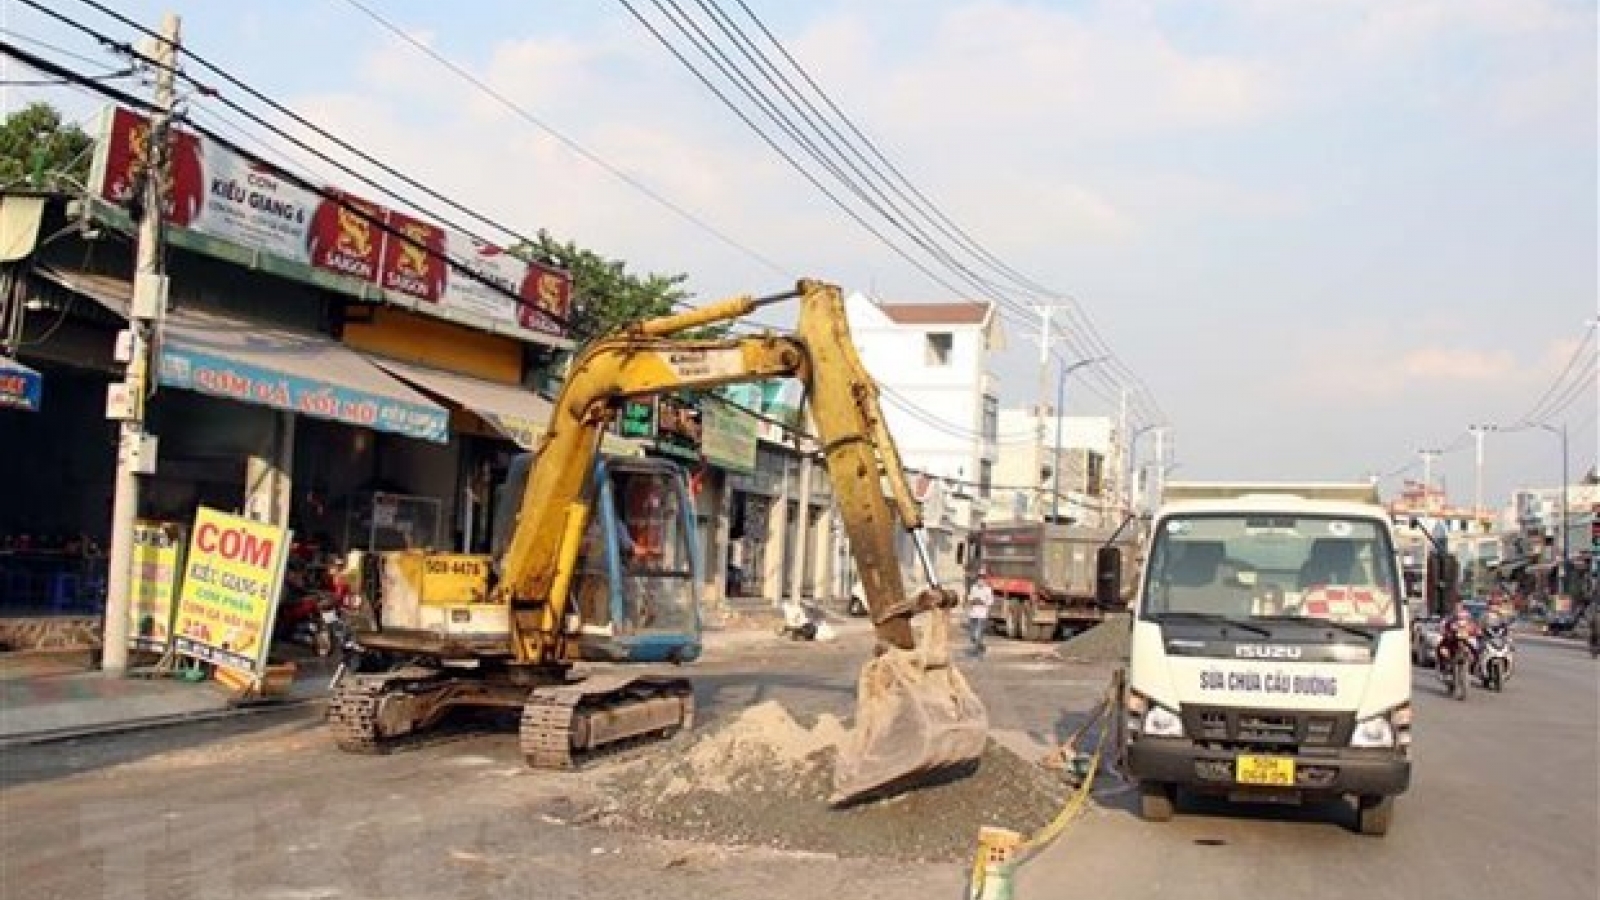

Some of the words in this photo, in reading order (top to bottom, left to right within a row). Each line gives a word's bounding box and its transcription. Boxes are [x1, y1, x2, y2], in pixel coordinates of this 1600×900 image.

[324, 250, 372, 278] SAIGON
[386, 271, 429, 297] SAIGON
[196, 521, 275, 570] CƠM
[1235, 644, 1302, 658] ISUZU
